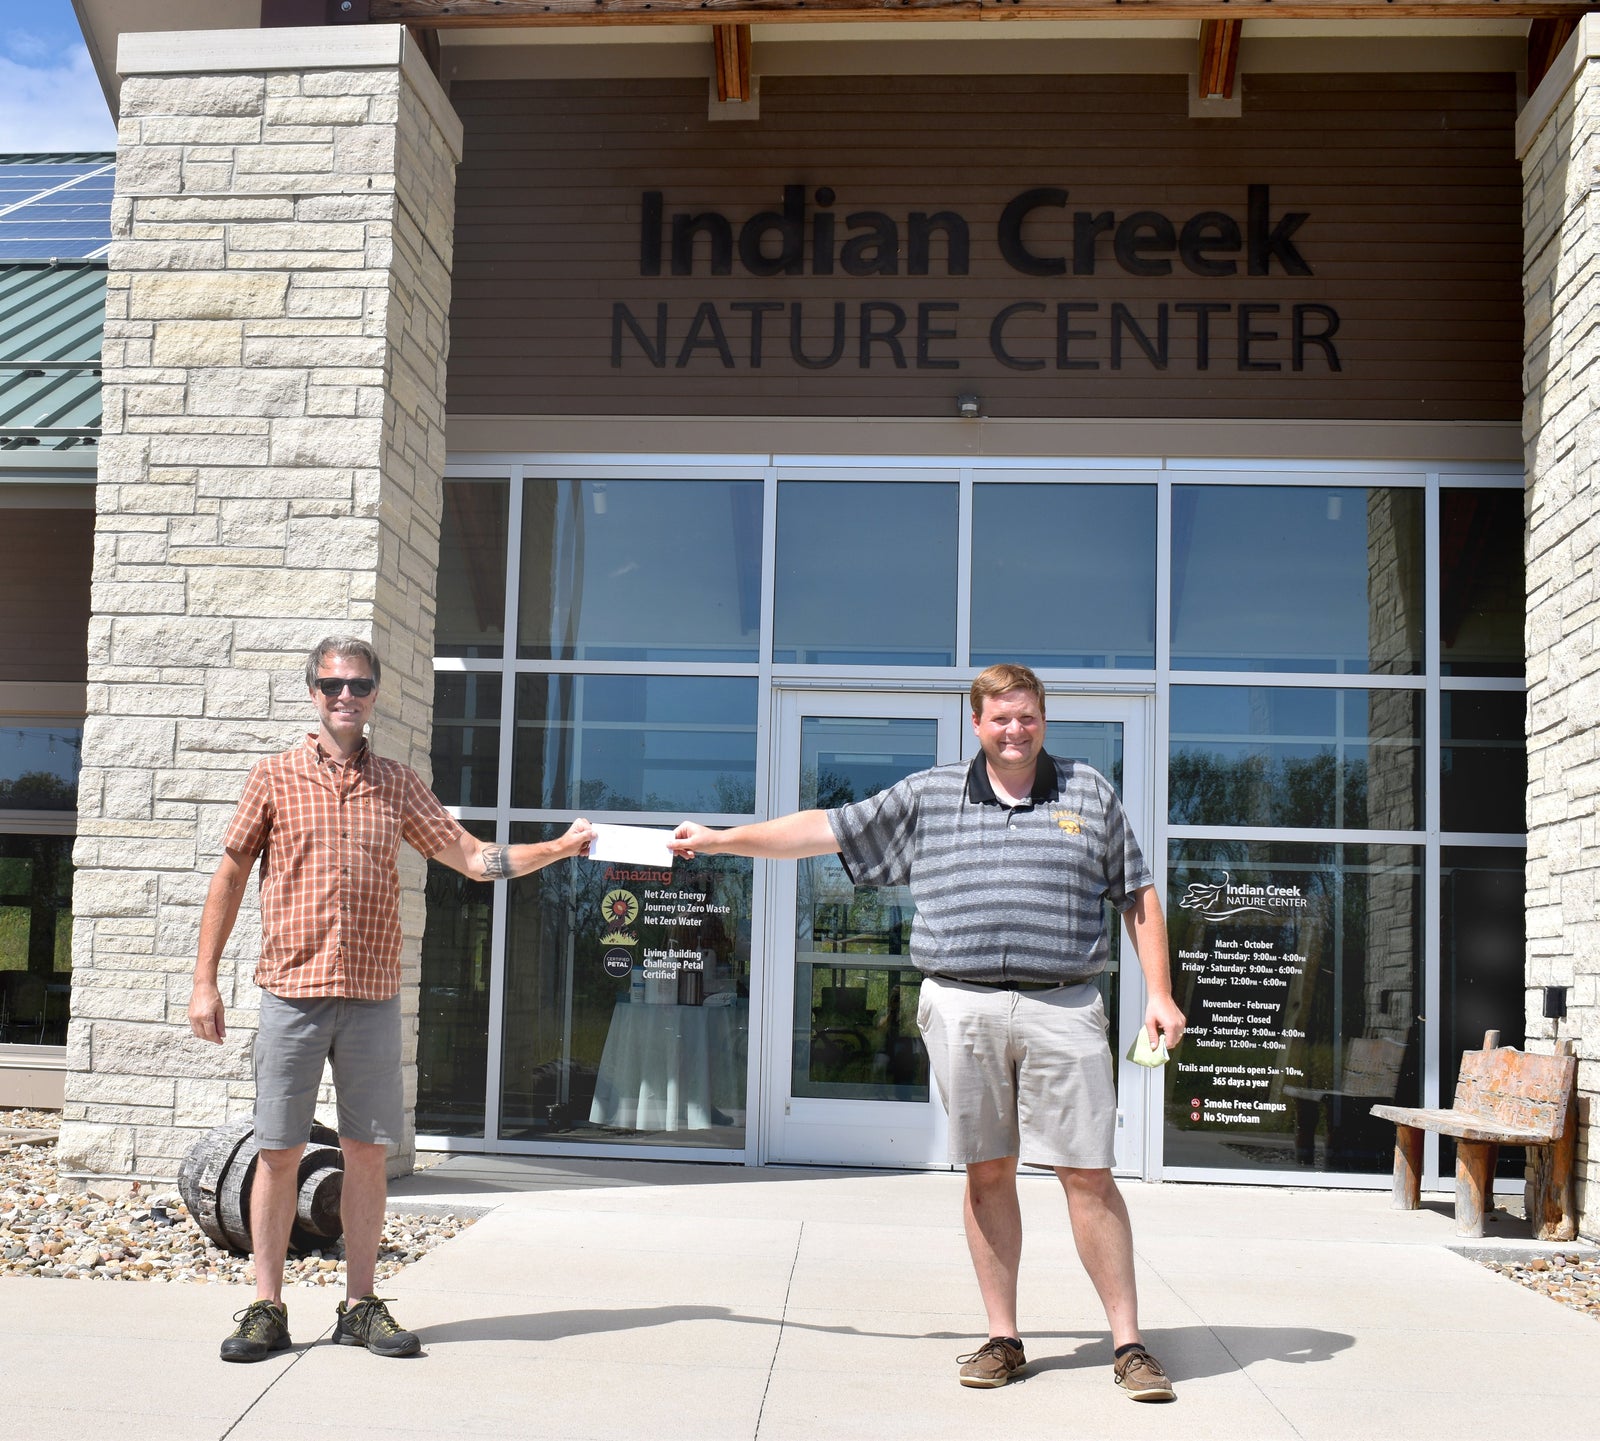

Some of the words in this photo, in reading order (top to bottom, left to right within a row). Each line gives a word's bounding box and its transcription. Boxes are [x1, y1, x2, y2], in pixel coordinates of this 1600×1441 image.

[639, 184, 970, 277] Indian
[997, 184, 1314, 277] Creek
[610, 301, 960, 370] NATURE
[988, 301, 1344, 372] CENTER
[604, 867, 672, 885] Amazing
[1226, 884, 1263, 895] Indian
[1266, 885, 1300, 896] Creek
[644, 890, 658, 899] Net
[660, 890, 678, 900] Zero
[679, 891, 706, 902] Energy
[1226, 896, 1266, 906] NATURE
[1268, 898, 1307, 907] CENTER
[644, 903, 675, 914] Journey
[687, 904, 704, 913] Zero
[706, 905, 730, 913] Waste
[644, 916, 658, 925] Net
[660, 916, 677, 925] Zero
[679, 917, 702, 926] Water
[1215, 940, 1238, 948] March
[1244, 941, 1274, 949] October
[644, 948, 667, 958] Living
[669, 949, 702, 960] Building
[1178, 950, 1208, 960] Monday
[1214, 951, 1250, 962] Thursday:
[643, 959, 681, 970] Challenge
[683, 960, 704, 970] Petal
[1182, 963, 1205, 973] Friday
[1210, 964, 1246, 974] Saturday:
[643, 970, 676, 979] Certified
[1197, 976, 1227, 986] Sunday:
[1203, 1000, 1240, 1008] November
[1247, 1001, 1280, 1012] February
[1212, 1014, 1244, 1024] Monday:
[1247, 1015, 1271, 1024] Closed
[1183, 1027, 1208, 1036] uesday
[1213, 1027, 1249, 1037] Saturday:
[1196, 1039, 1226, 1049] Sunday:
[1178, 1063, 1198, 1072] Trails
[1199, 1064, 1213, 1072] and
[1215, 1065, 1245, 1074] grounds
[1213, 1077, 1226, 1085] 365
[1228, 1077, 1244, 1088] days
[1252, 1080, 1269, 1088] year
[1204, 1099, 1232, 1108] Smoke
[1234, 1100, 1252, 1109] Free
[1254, 1101, 1286, 1112] Campus
[1204, 1112, 1215, 1121] No
[1217, 1112, 1260, 1124] Styrofoam
